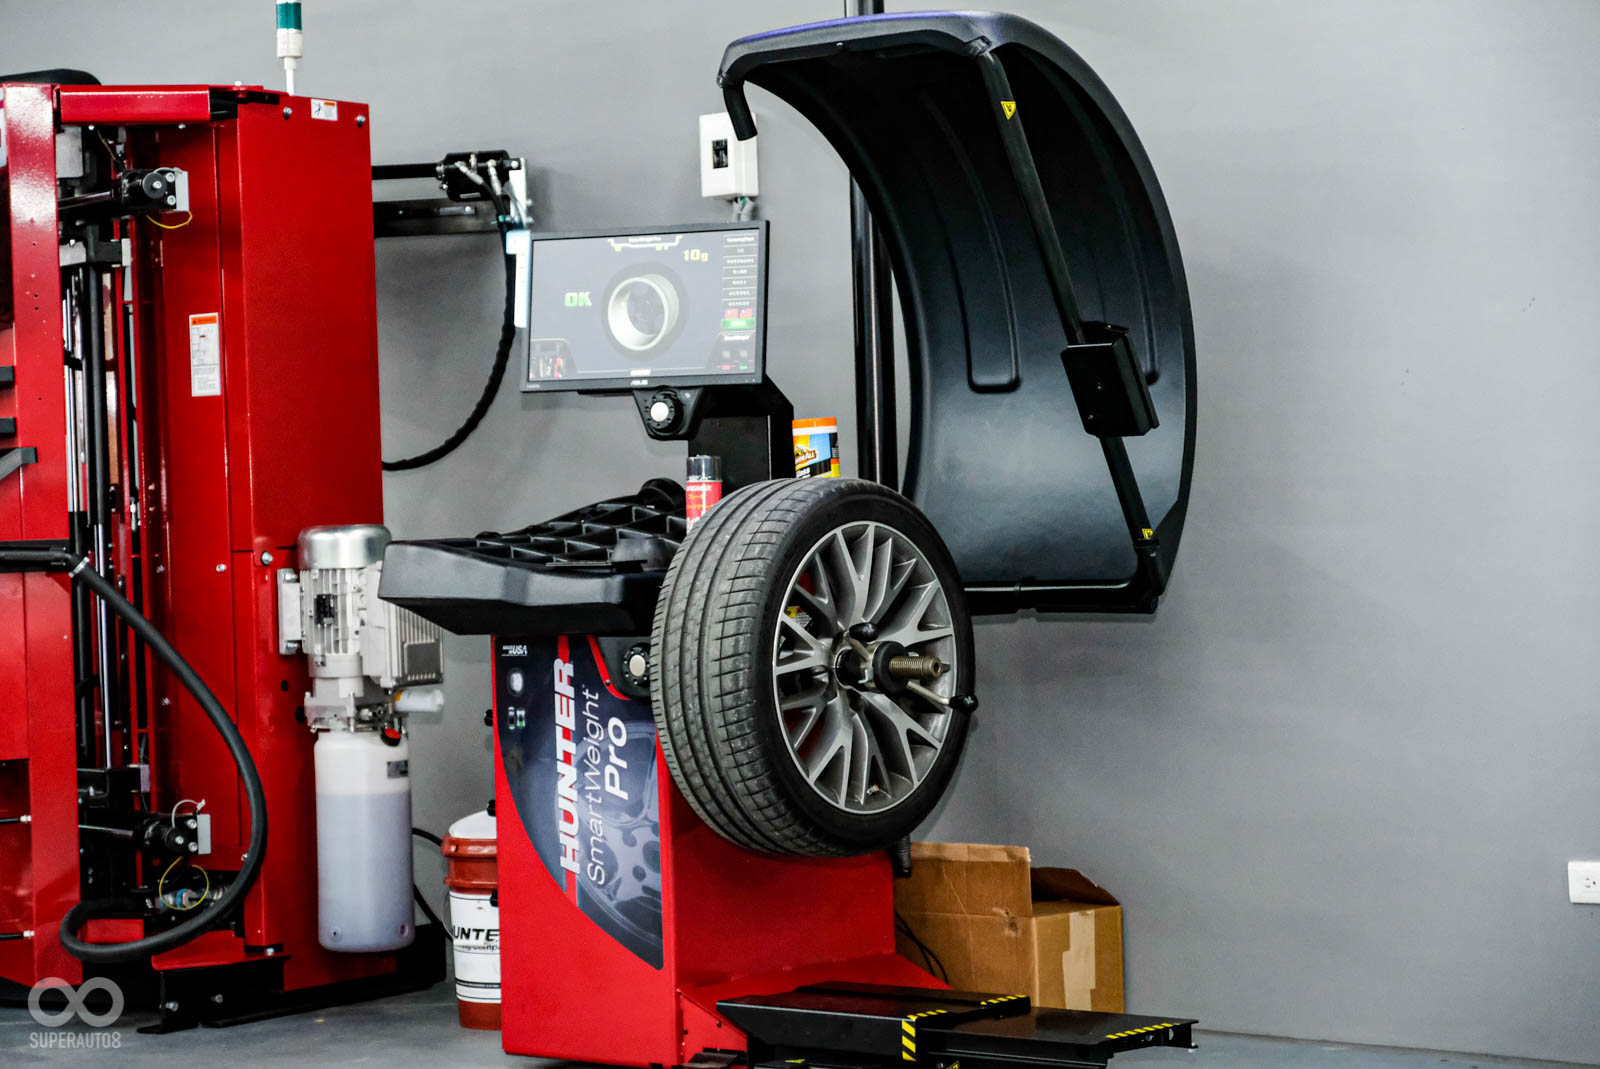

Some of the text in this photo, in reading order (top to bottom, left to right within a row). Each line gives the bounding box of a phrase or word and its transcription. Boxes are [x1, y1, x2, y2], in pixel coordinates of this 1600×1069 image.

[683, 249, 709, 262] 10g
[564, 291, 592, 307] OK
[512, 645, 527, 654] USA
[553, 657, 581, 875] HUNTER
[604, 716, 629, 801] Pro
[582, 688, 606, 886] SmartWeight
[453, 925, 500, 942] UNTE
